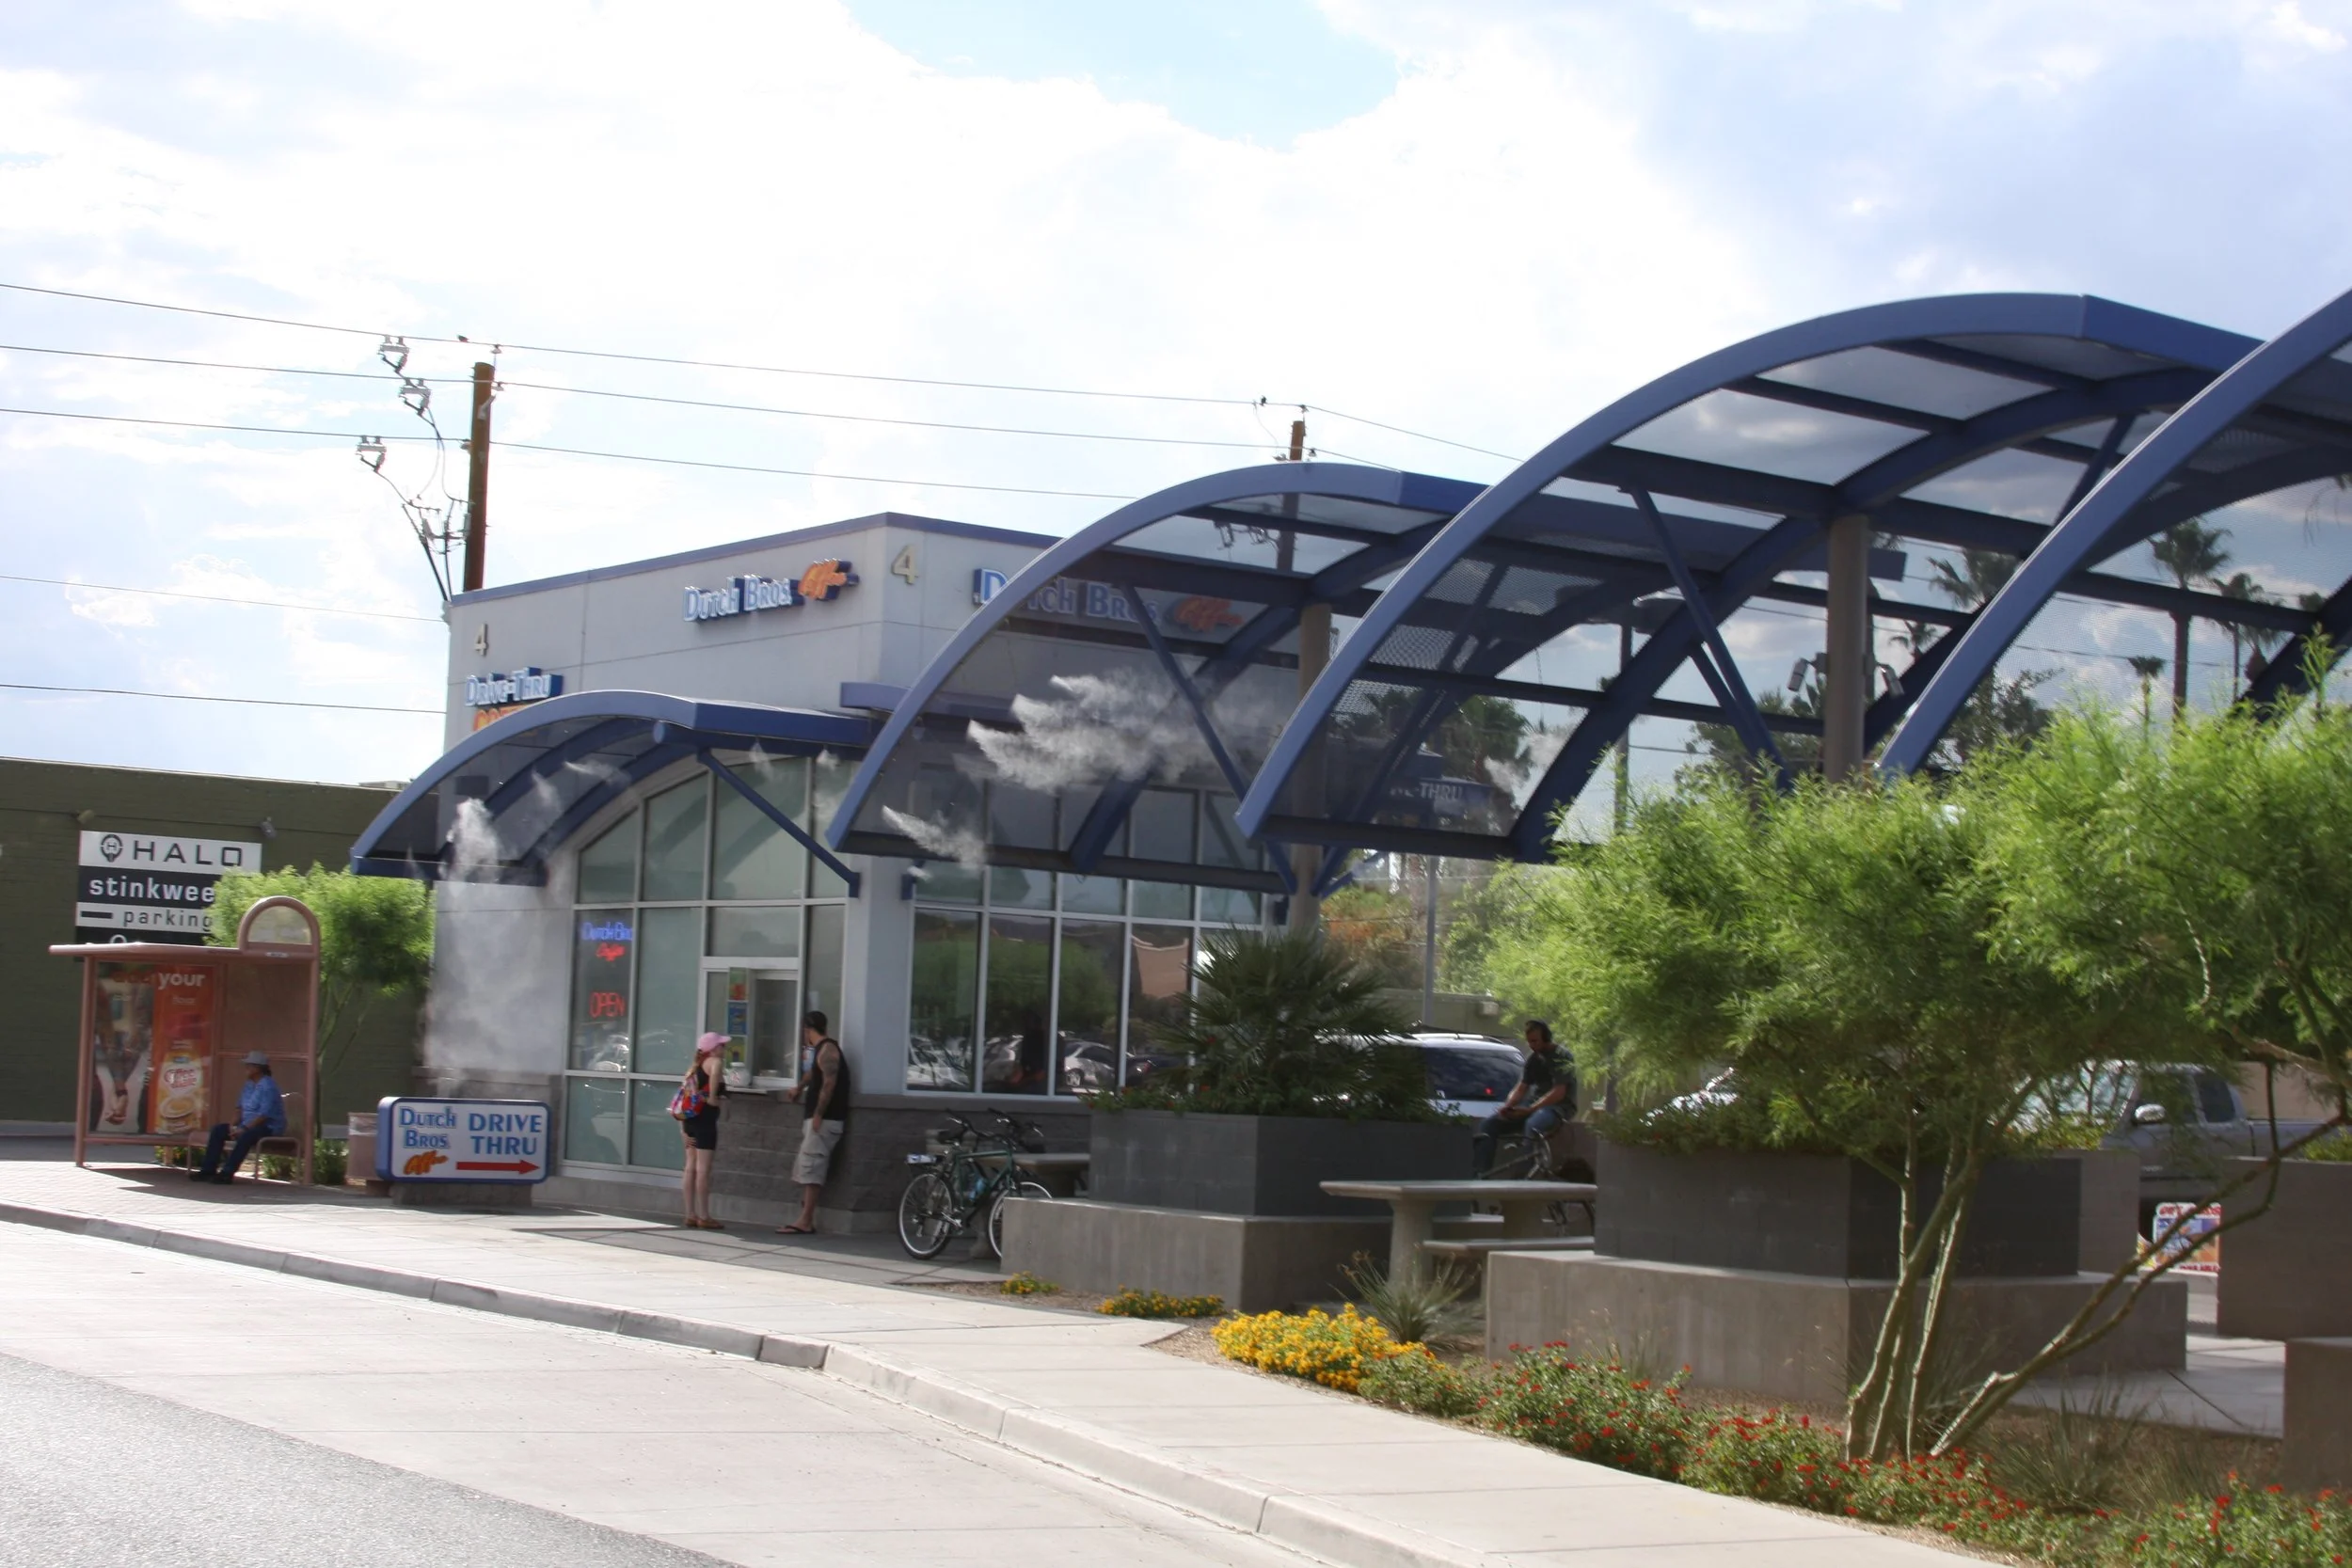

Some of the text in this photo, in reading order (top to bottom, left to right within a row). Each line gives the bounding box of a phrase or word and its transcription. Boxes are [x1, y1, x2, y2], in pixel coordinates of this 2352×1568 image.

[891, 545, 918, 585] 4
[474, 623, 489, 657] 4
[133, 840, 243, 867] HALO
[88, 875, 215, 903] stinkwee
[122, 909, 213, 933] parking
[157, 972, 206, 990] your
[589, 991, 626, 1019] OPEN
[469, 1113, 542, 1133] DRIVE
[471, 1135, 537, 1155] THRU
